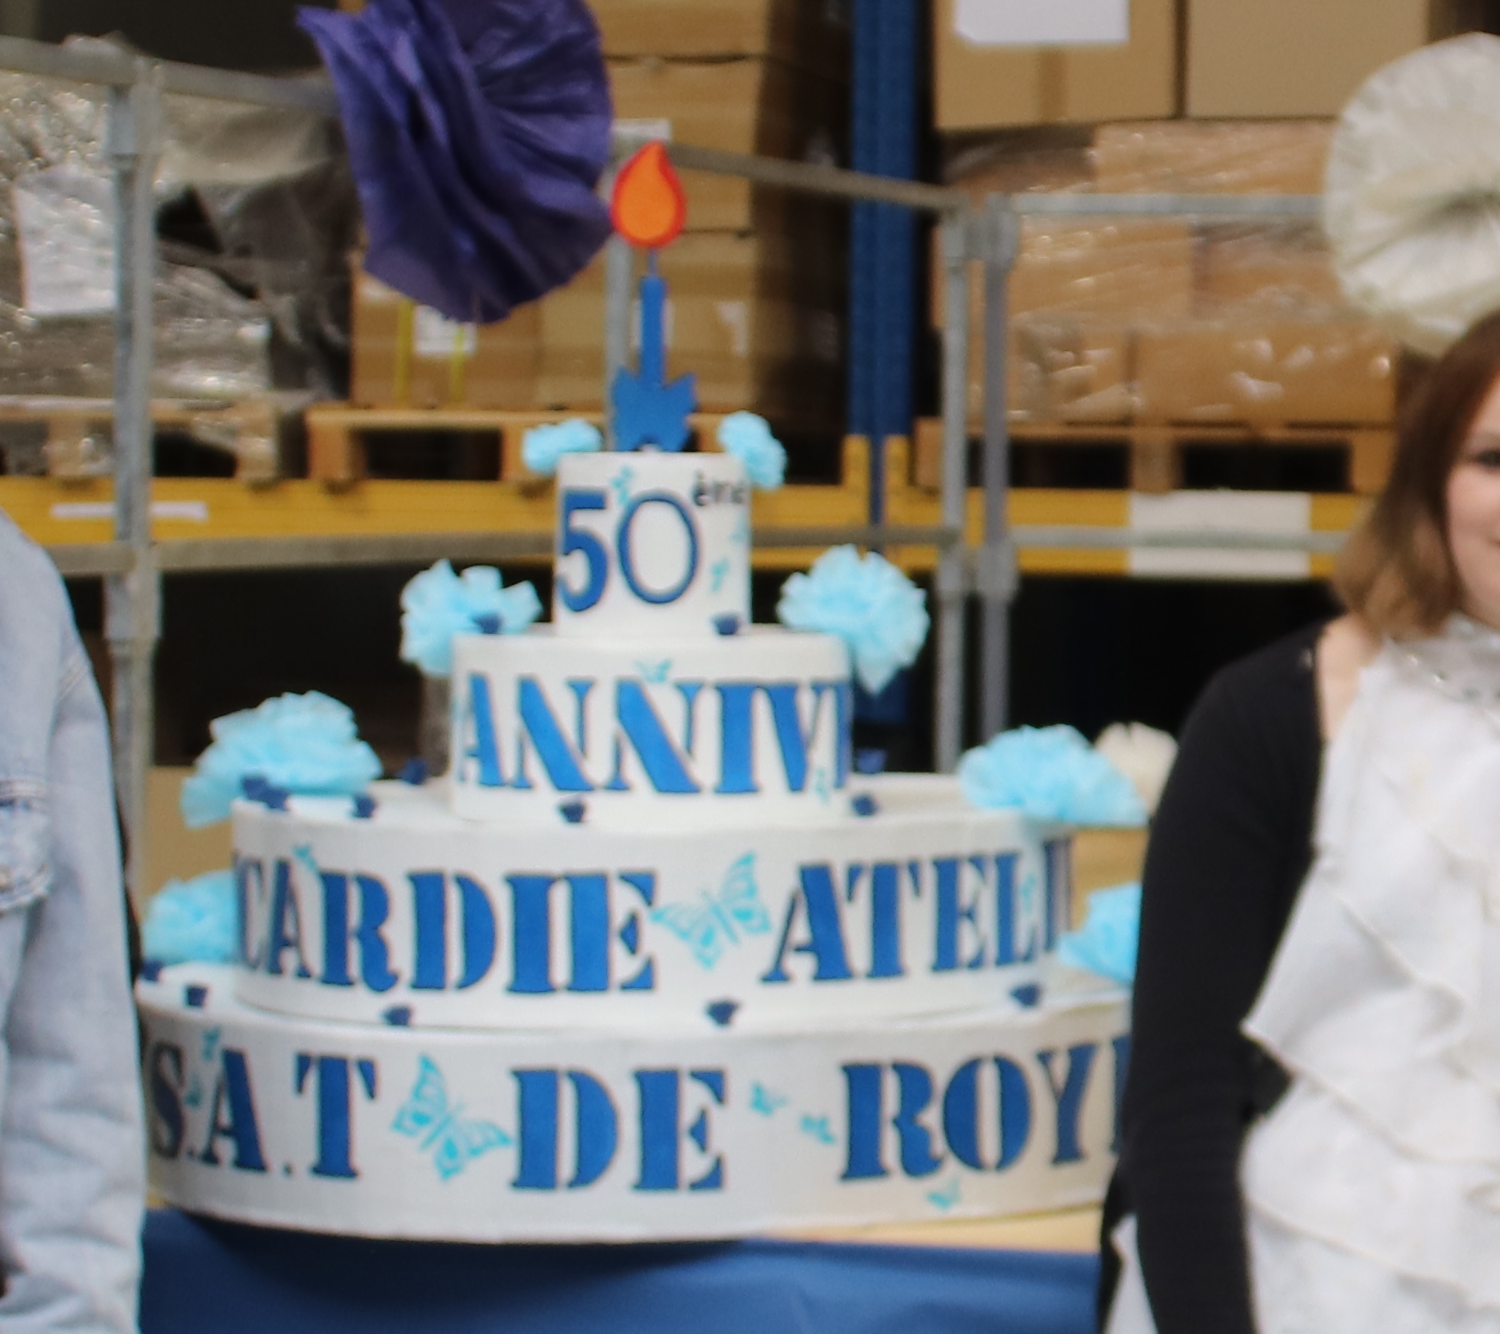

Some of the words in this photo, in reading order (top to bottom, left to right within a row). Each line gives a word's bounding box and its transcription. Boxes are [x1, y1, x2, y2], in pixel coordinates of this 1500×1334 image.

[232, 849, 657, 993] CARDIE
[760, 839, 1072, 983] ATELI
[509, 1067, 726, 1193] DE
